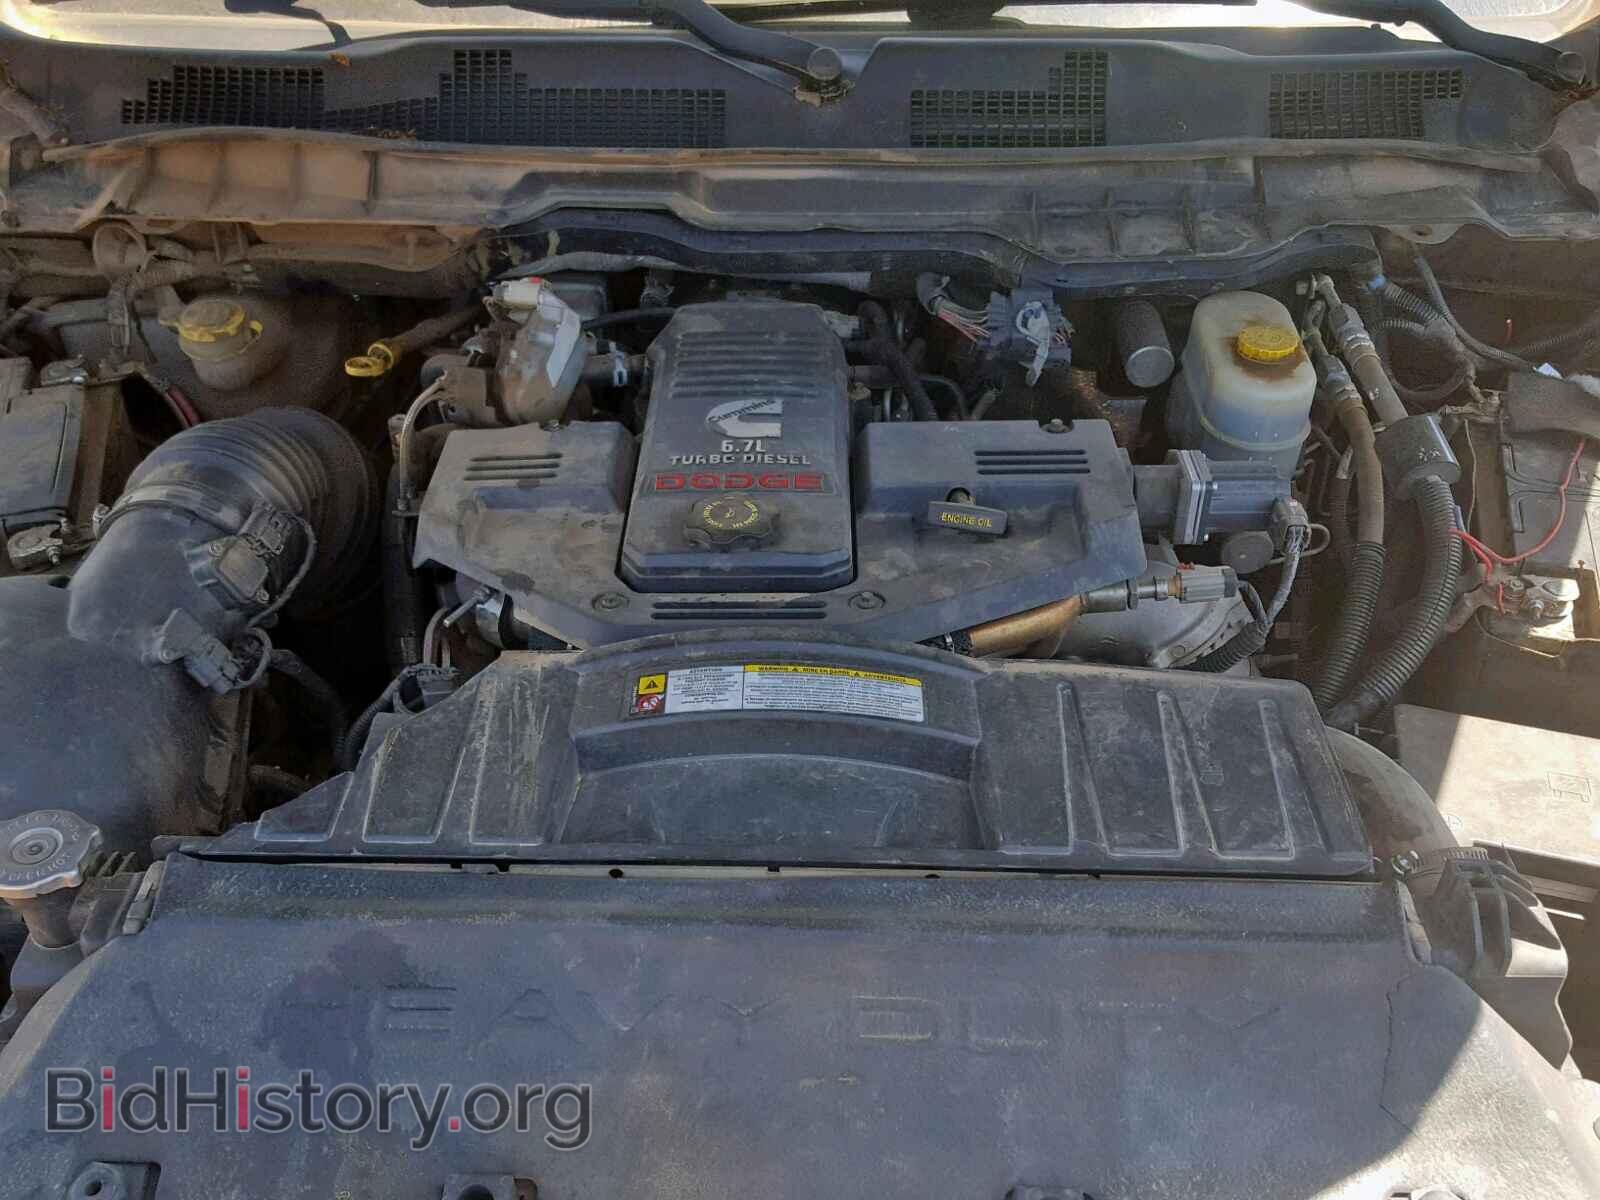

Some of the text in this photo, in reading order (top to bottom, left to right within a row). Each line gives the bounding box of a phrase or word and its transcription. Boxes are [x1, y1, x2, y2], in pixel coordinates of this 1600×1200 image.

[721, 439, 767, 453] 6.7L
[669, 453, 811, 467] TURBO DIESEL
[655, 472, 825, 490] DODGE
[941, 511, 993, 528] ENGINE OIL
